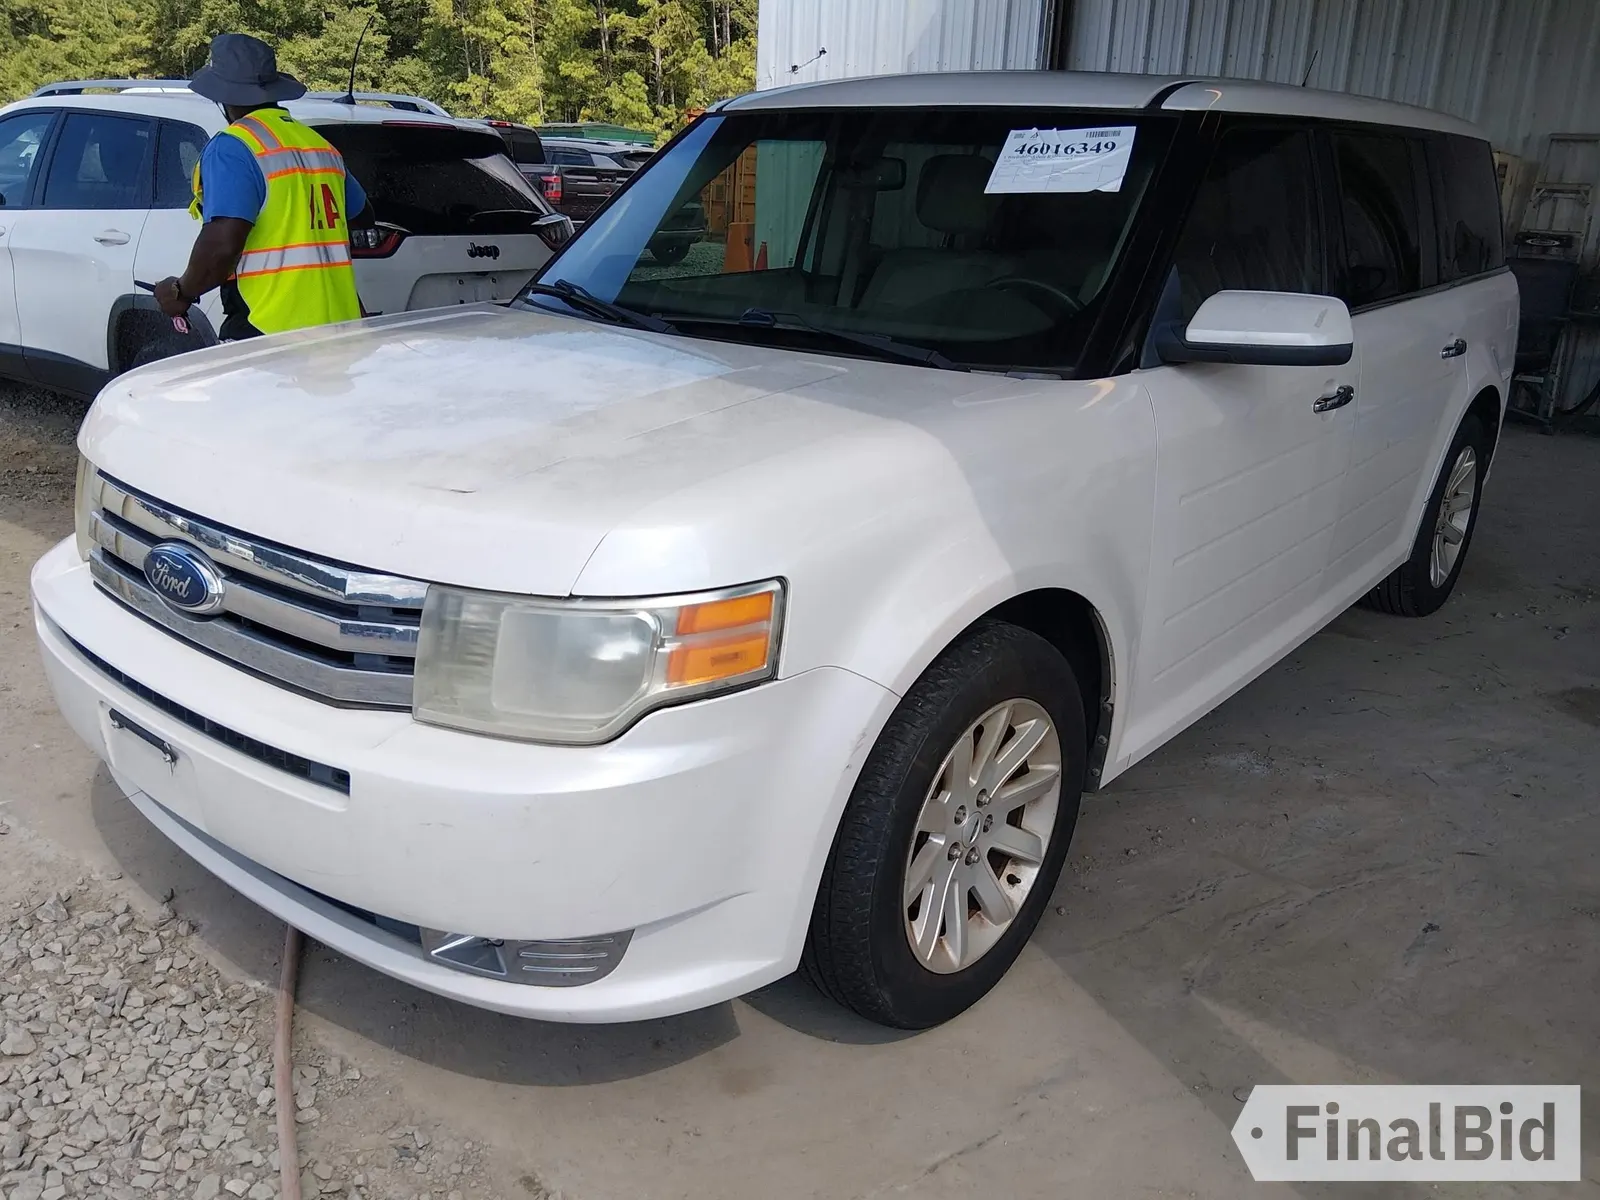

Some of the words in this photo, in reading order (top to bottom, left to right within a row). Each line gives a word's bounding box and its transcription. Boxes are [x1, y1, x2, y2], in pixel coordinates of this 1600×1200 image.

[1014, 141, 1117, 155] 46016349
[466, 242, 501, 260] Jeep
[149, 555, 191, 598] Ford
